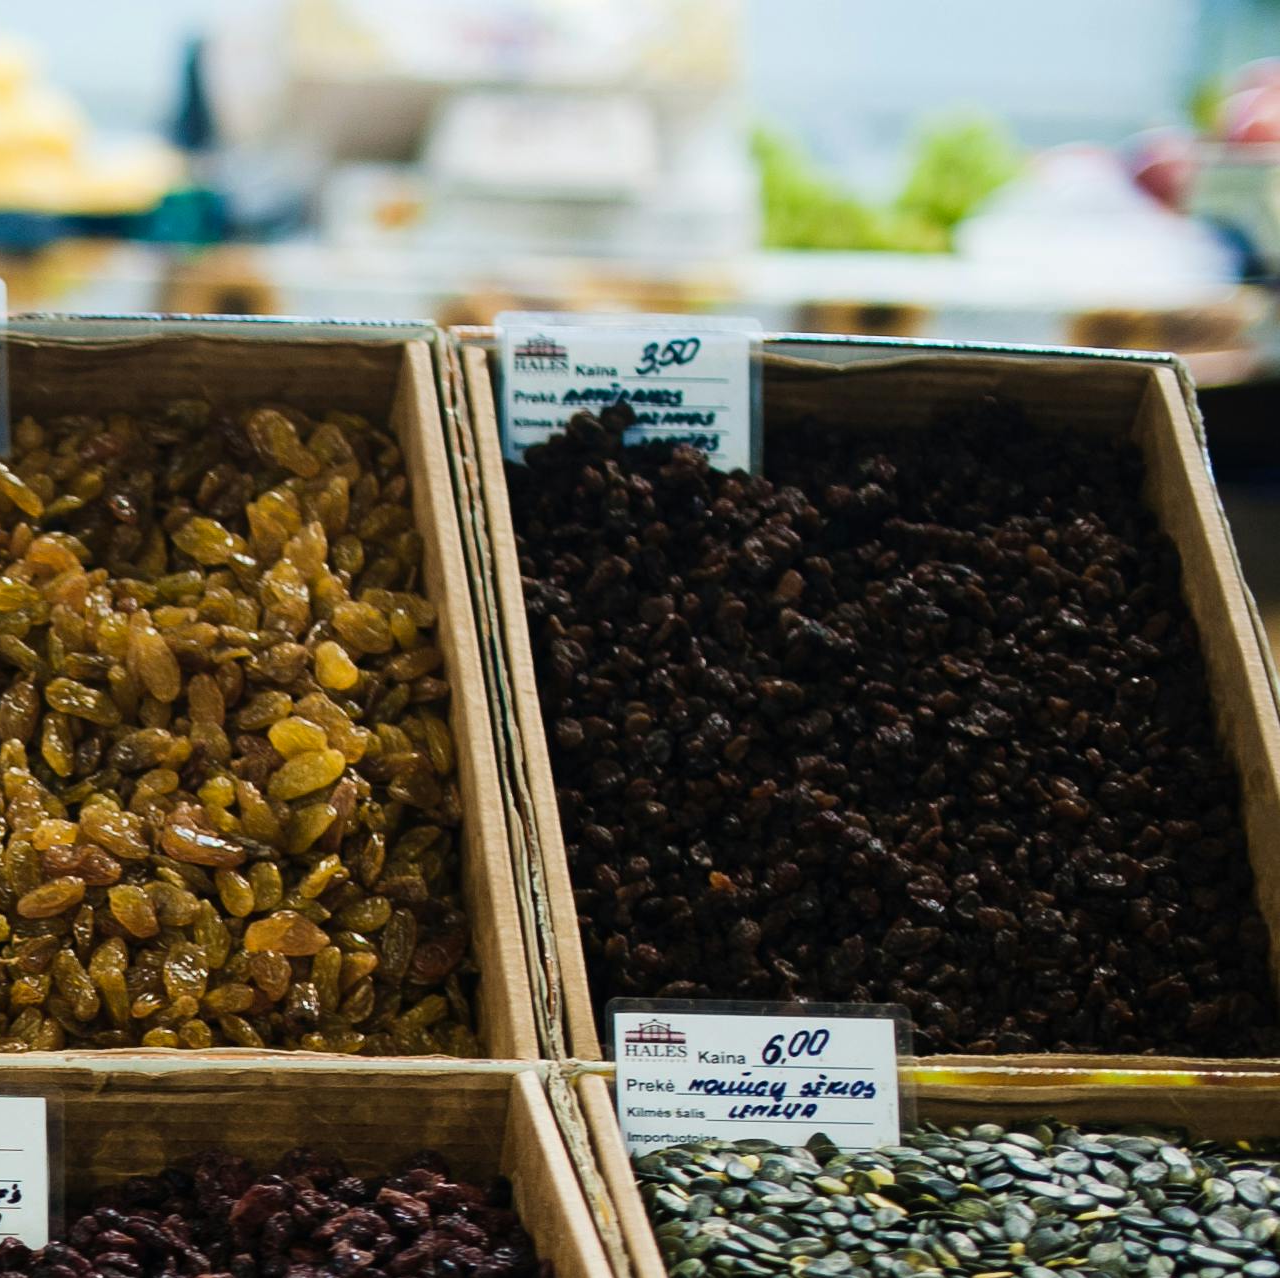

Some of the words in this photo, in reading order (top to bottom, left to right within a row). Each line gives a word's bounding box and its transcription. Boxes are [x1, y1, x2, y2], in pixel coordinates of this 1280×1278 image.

[575, 365, 618, 377] Kaina
[697, 1051, 747, 1065] Kaina
[761, 1028, 830, 1066] 6,00
[626, 1079, 676, 1093] Prekė
[626, 1106, 672, 1119] Kilmės
[675, 1106, 706, 1119] šalis
